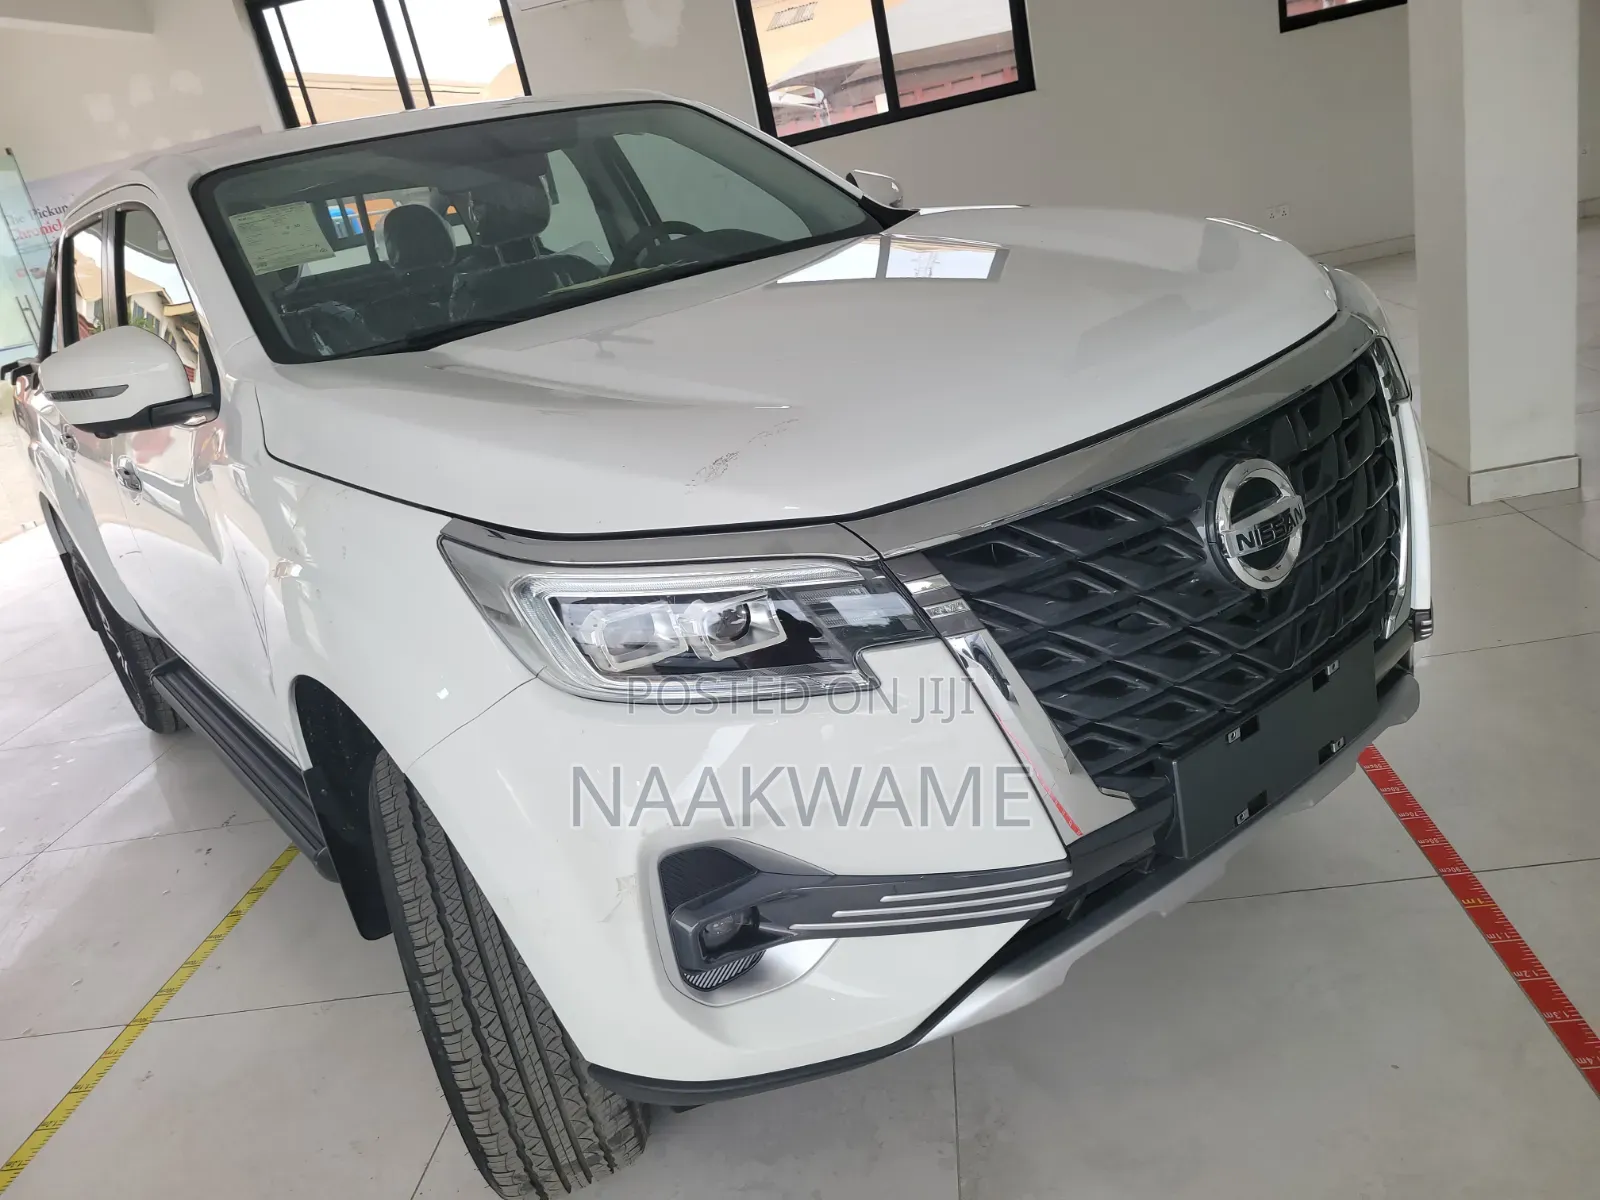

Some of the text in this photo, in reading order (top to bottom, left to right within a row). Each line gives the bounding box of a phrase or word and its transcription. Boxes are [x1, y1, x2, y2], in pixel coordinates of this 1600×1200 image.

[1235, 503, 1304, 551] NISSAN
[1461, 897, 1484, 905] 1m
[1486, 932, 1511, 940] 1.1m
[1513, 969, 1539, 978] 1.2m
[1543, 1010, 1570, 1019] 1.3m
